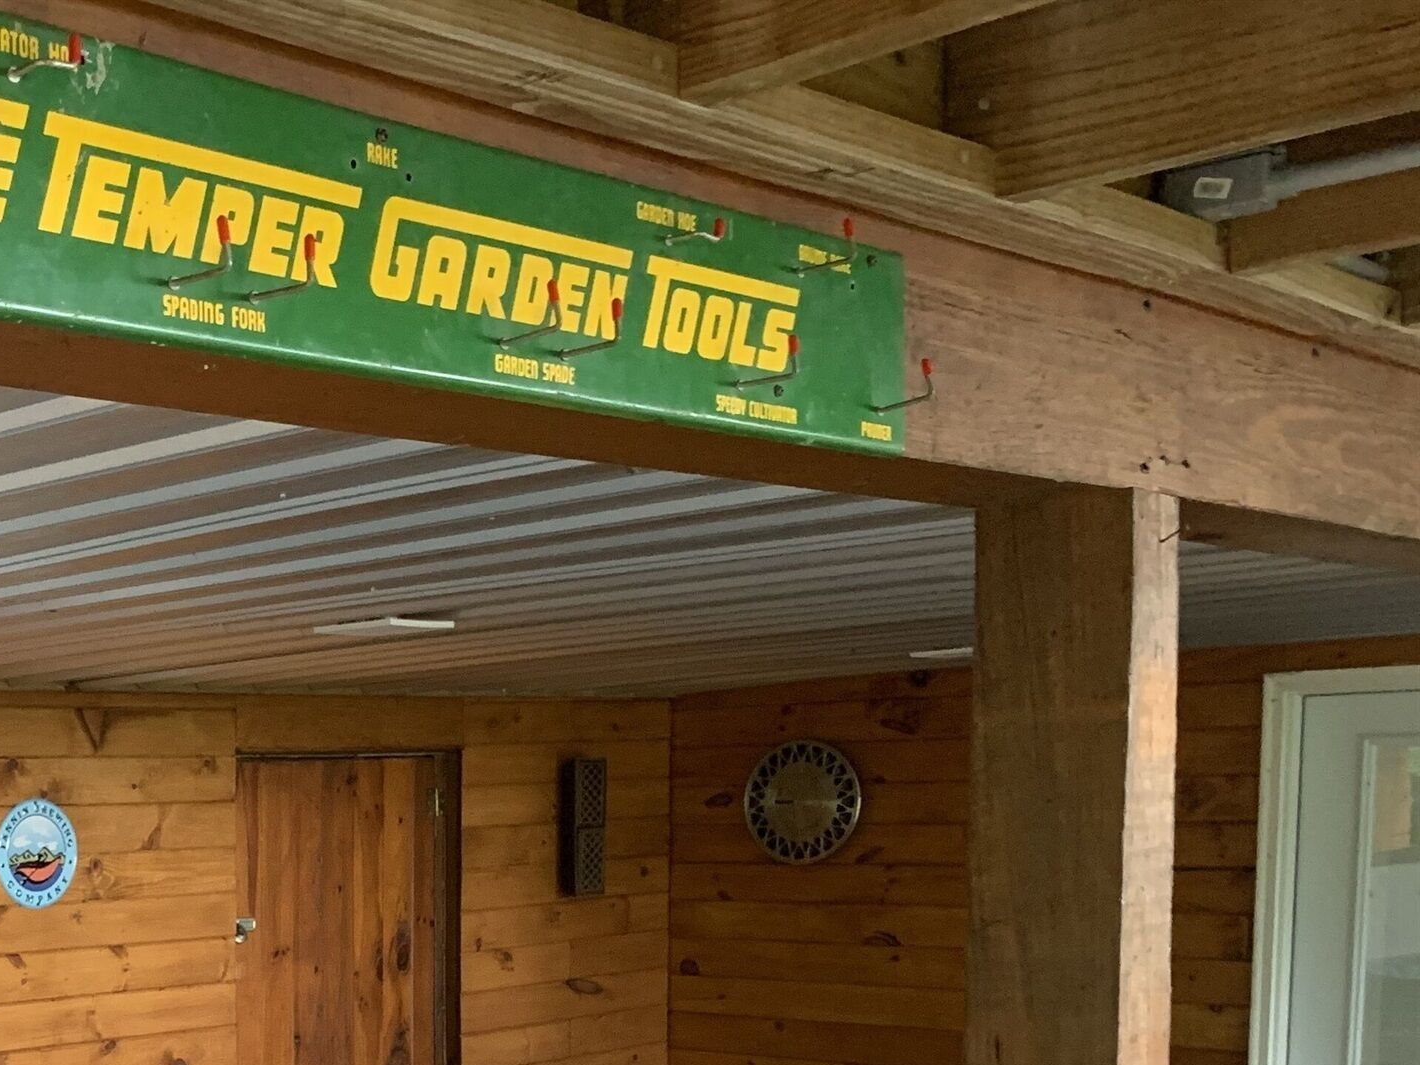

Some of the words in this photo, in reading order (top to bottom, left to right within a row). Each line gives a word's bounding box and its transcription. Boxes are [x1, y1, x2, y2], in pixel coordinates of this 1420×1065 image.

[366, 142, 398, 169] RAKE
[39, 111, 363, 288] TEMPER
[369, 196, 633, 342] GARDEN
[643, 254, 800, 373] TOOLS
[162, 294, 225, 325] SPADING
[231, 305, 266, 332] FORK
[494, 353, 539, 380] GARDEN
[542, 362, 576, 386] SPADE
[7, 875, 69, 906] COMPANY
